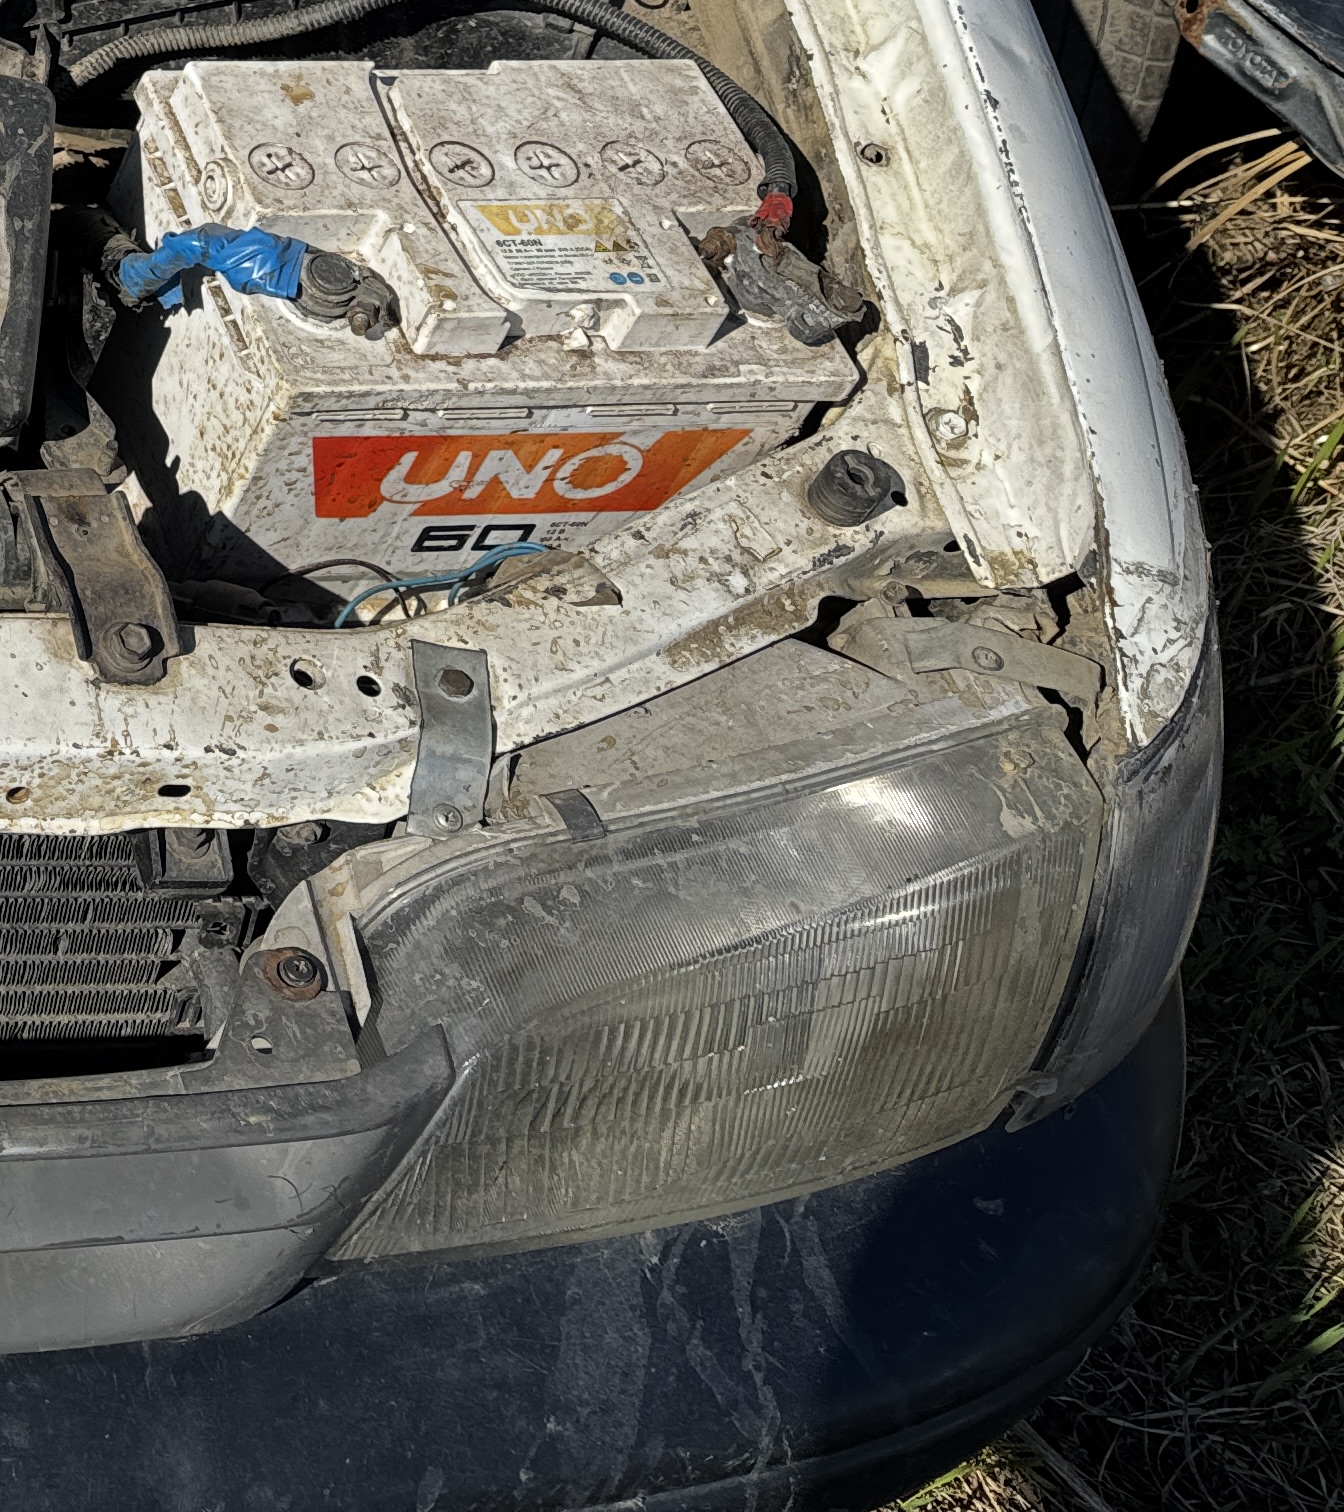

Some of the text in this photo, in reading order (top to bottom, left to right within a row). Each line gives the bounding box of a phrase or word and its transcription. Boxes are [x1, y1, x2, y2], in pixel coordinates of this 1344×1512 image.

[508, 202, 596, 235] UNO
[380, 442, 644, 504] UNO
[410, 523, 537, 553] 60
